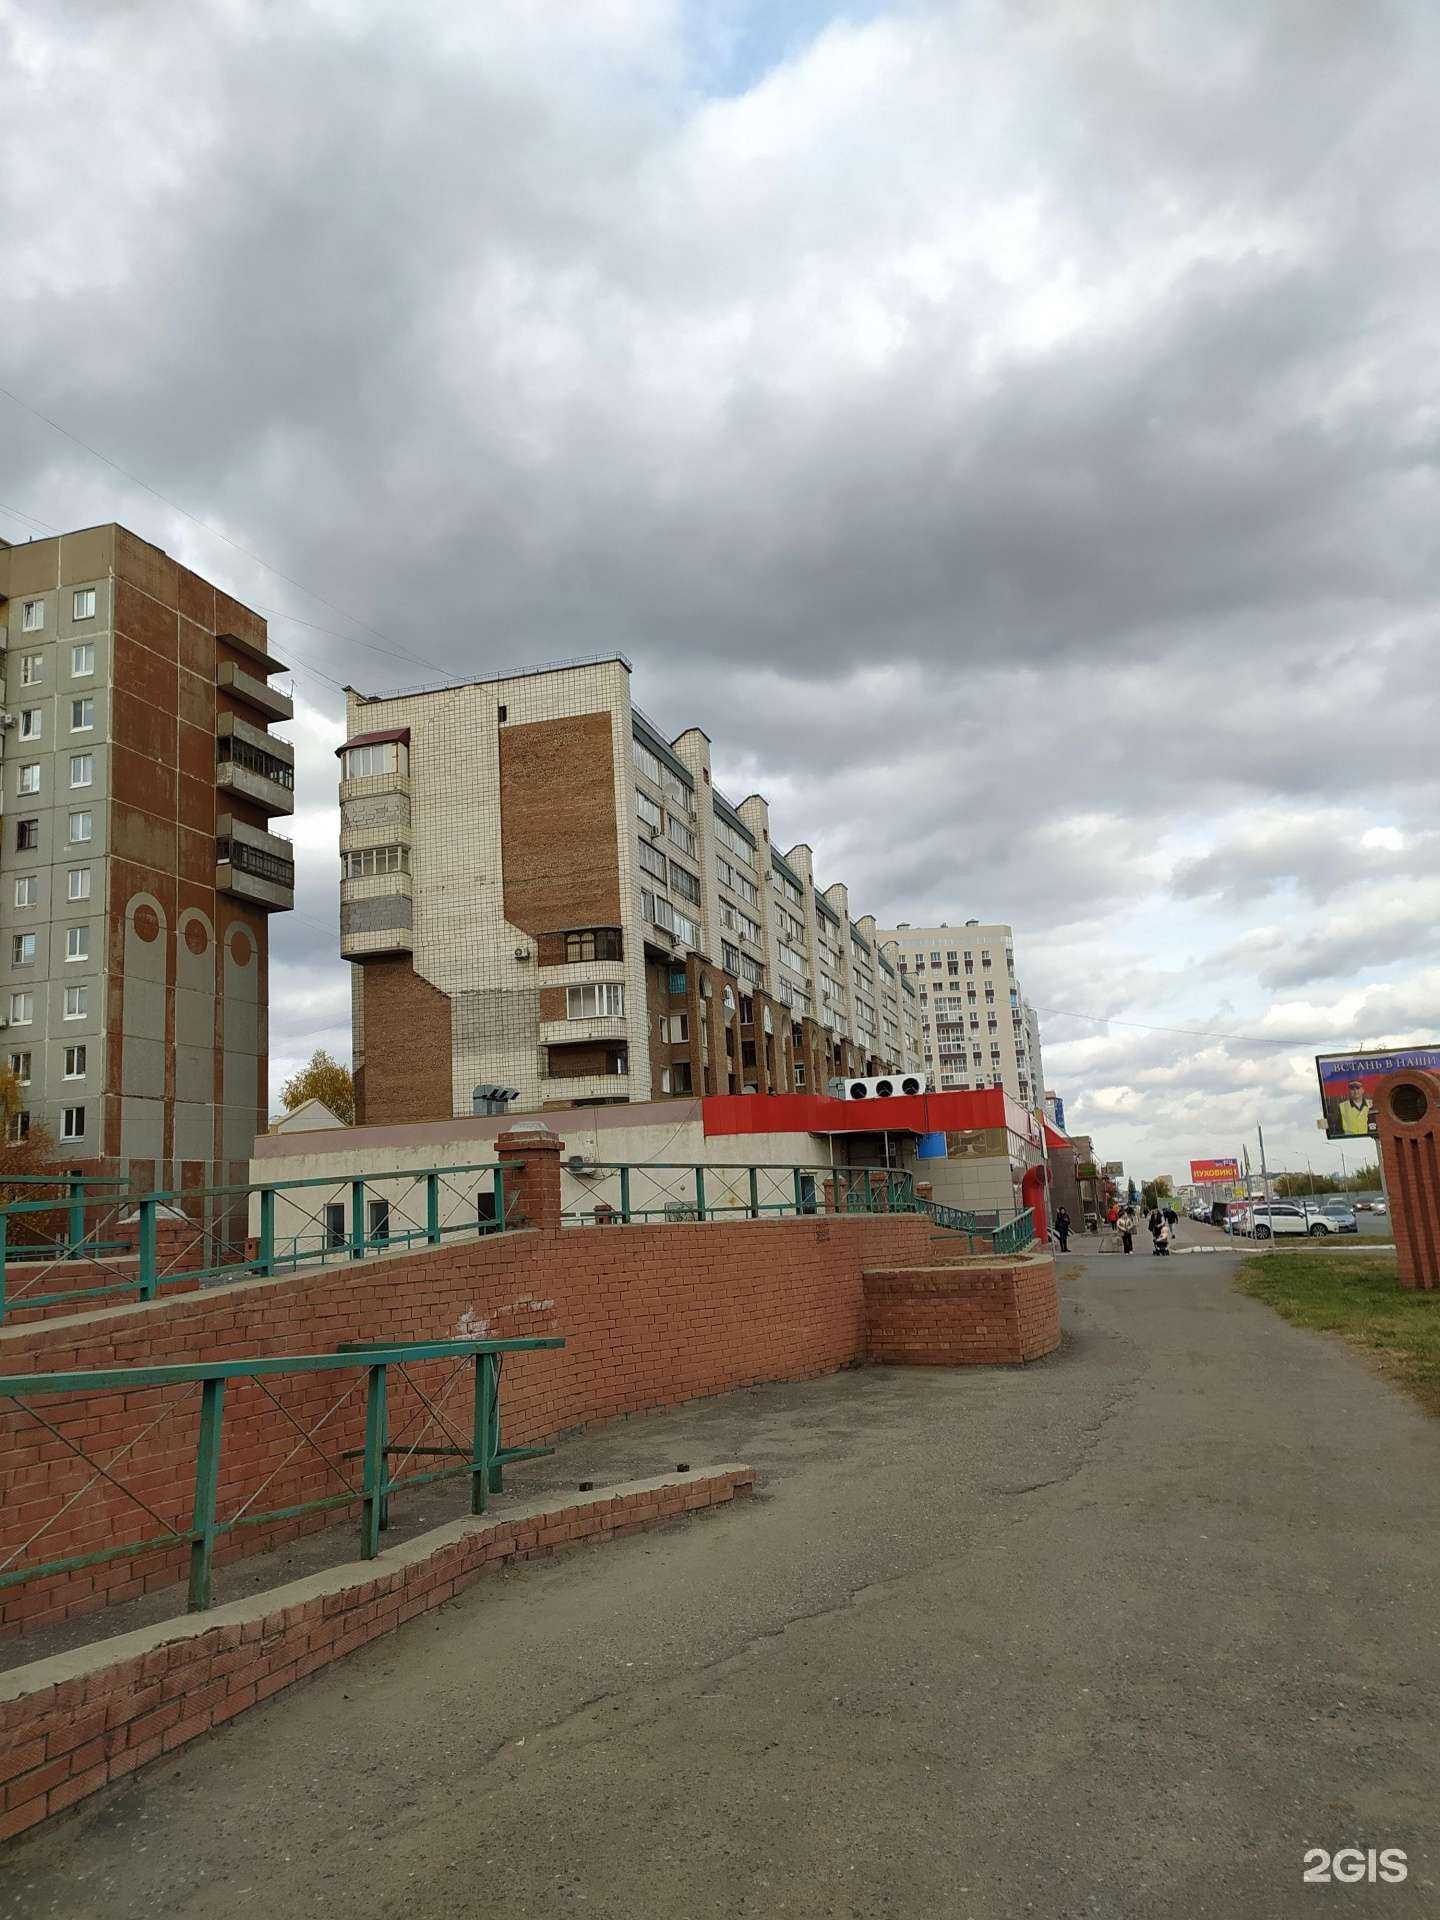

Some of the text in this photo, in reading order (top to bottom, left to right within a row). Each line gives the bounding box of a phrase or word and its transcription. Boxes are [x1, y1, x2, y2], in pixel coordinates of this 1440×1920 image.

[1334, 1056, 1436, 1072] ВСТАНЬ В НАШИ
